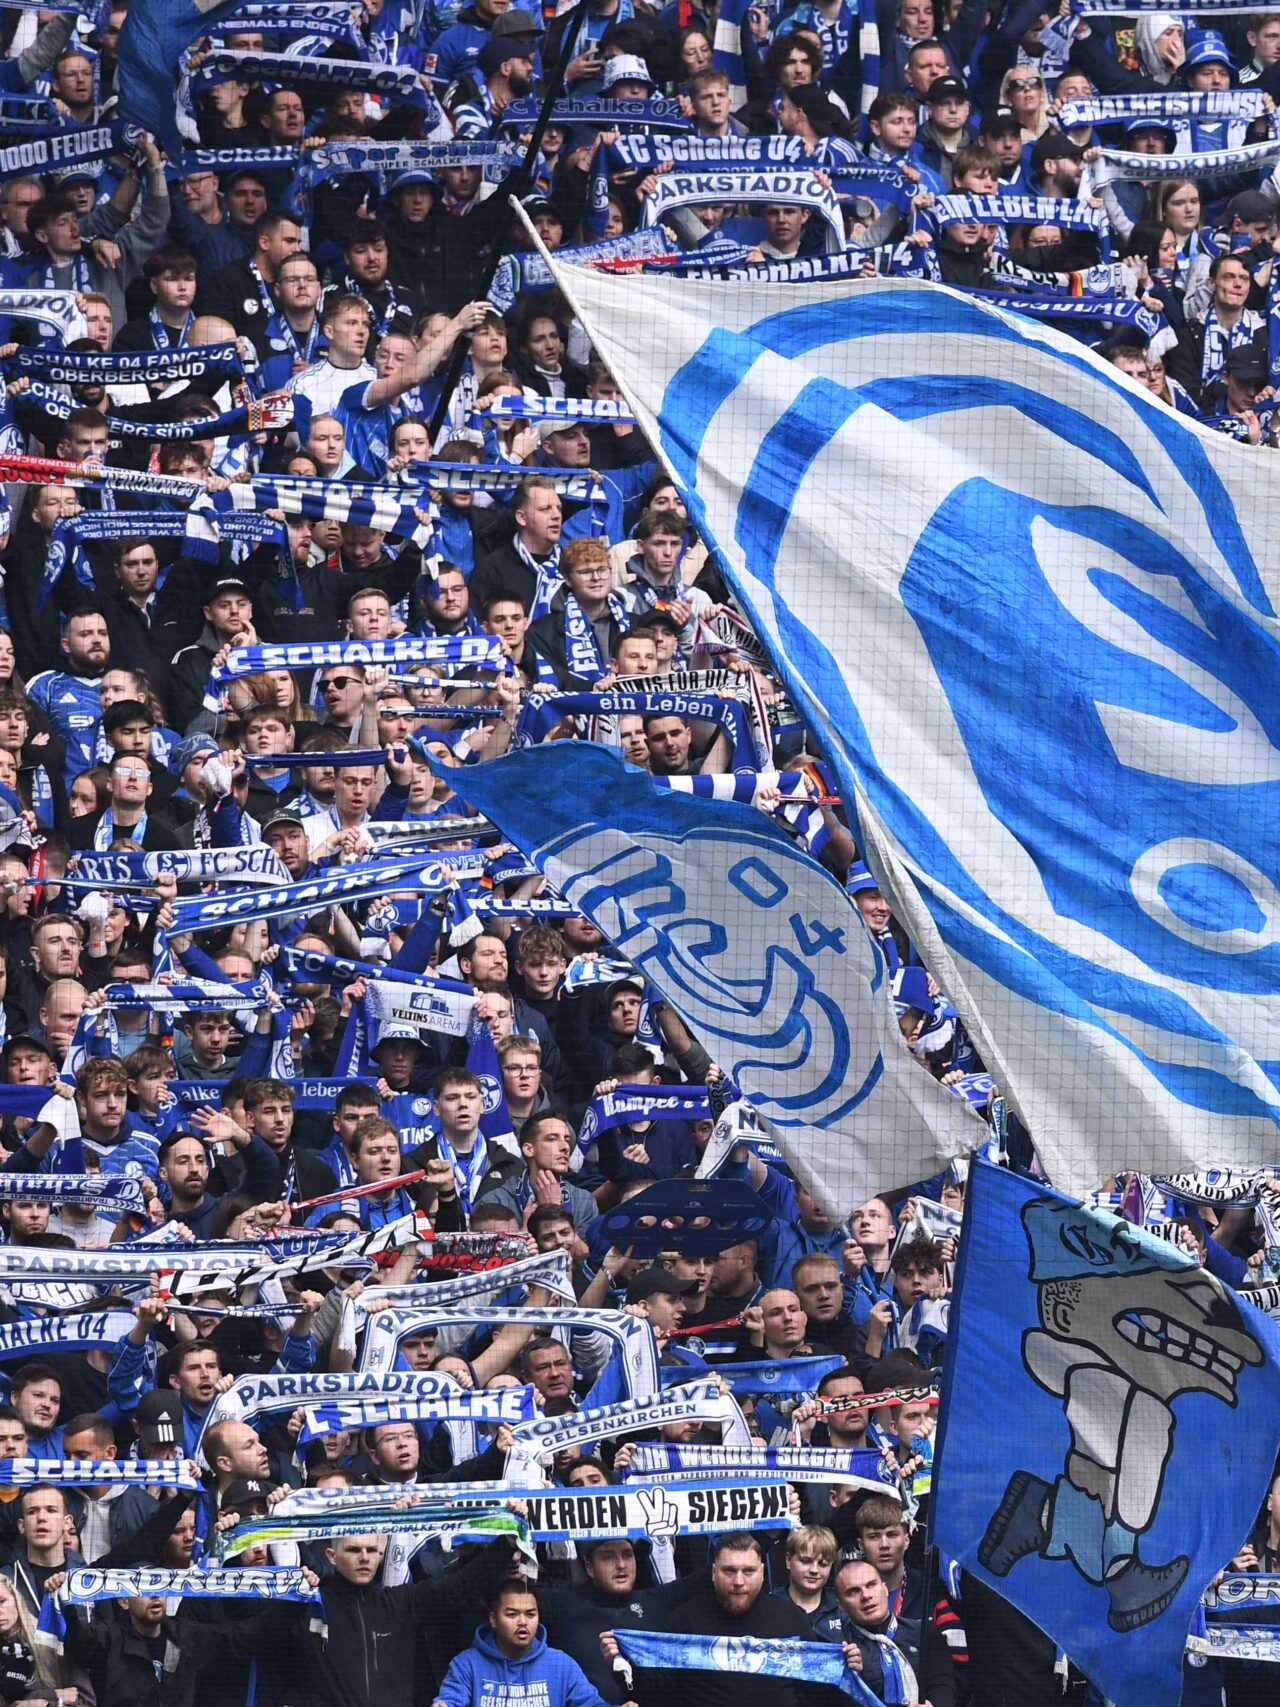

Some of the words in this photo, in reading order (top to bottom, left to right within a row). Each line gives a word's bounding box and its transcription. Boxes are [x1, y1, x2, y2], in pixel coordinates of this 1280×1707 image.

[312, 5, 350, 23] 04
[218, 19, 287, 30] NIEMALS
[291, 20, 346, 35] ENDET!
[374, 70, 416, 94] 04
[52, 127, 113, 160] FEUER
[616, 138, 650, 164] FC
[655, 138, 762, 162] Schalke
[770, 136, 803, 166] 04
[19, 353, 116, 370] SCHALKE
[119, 356, 142, 369] 04
[262, 640, 446, 669] SCHALKE
[600, 693, 637, 710] ein
[645, 694, 714, 717] Leben
[199, 852, 225, 876] FC
[391, 1007, 428, 1025] VELTINS
[428, 1013, 463, 1032] ARENA
[78, 1313, 106, 1339] 04
[345, 1386, 526, 1424] SCHALKE
[541, 1403, 697, 1449] GELSENKIRCHEN
[678, 1445, 767, 1467] WERDEN
[776, 1447, 853, 1470] SIEGEN
[688, 1486, 789, 1524] SIEGEN!
[332, 1525, 379, 1536] IMMER
[380, 1521, 438, 1535] SCHALKE
